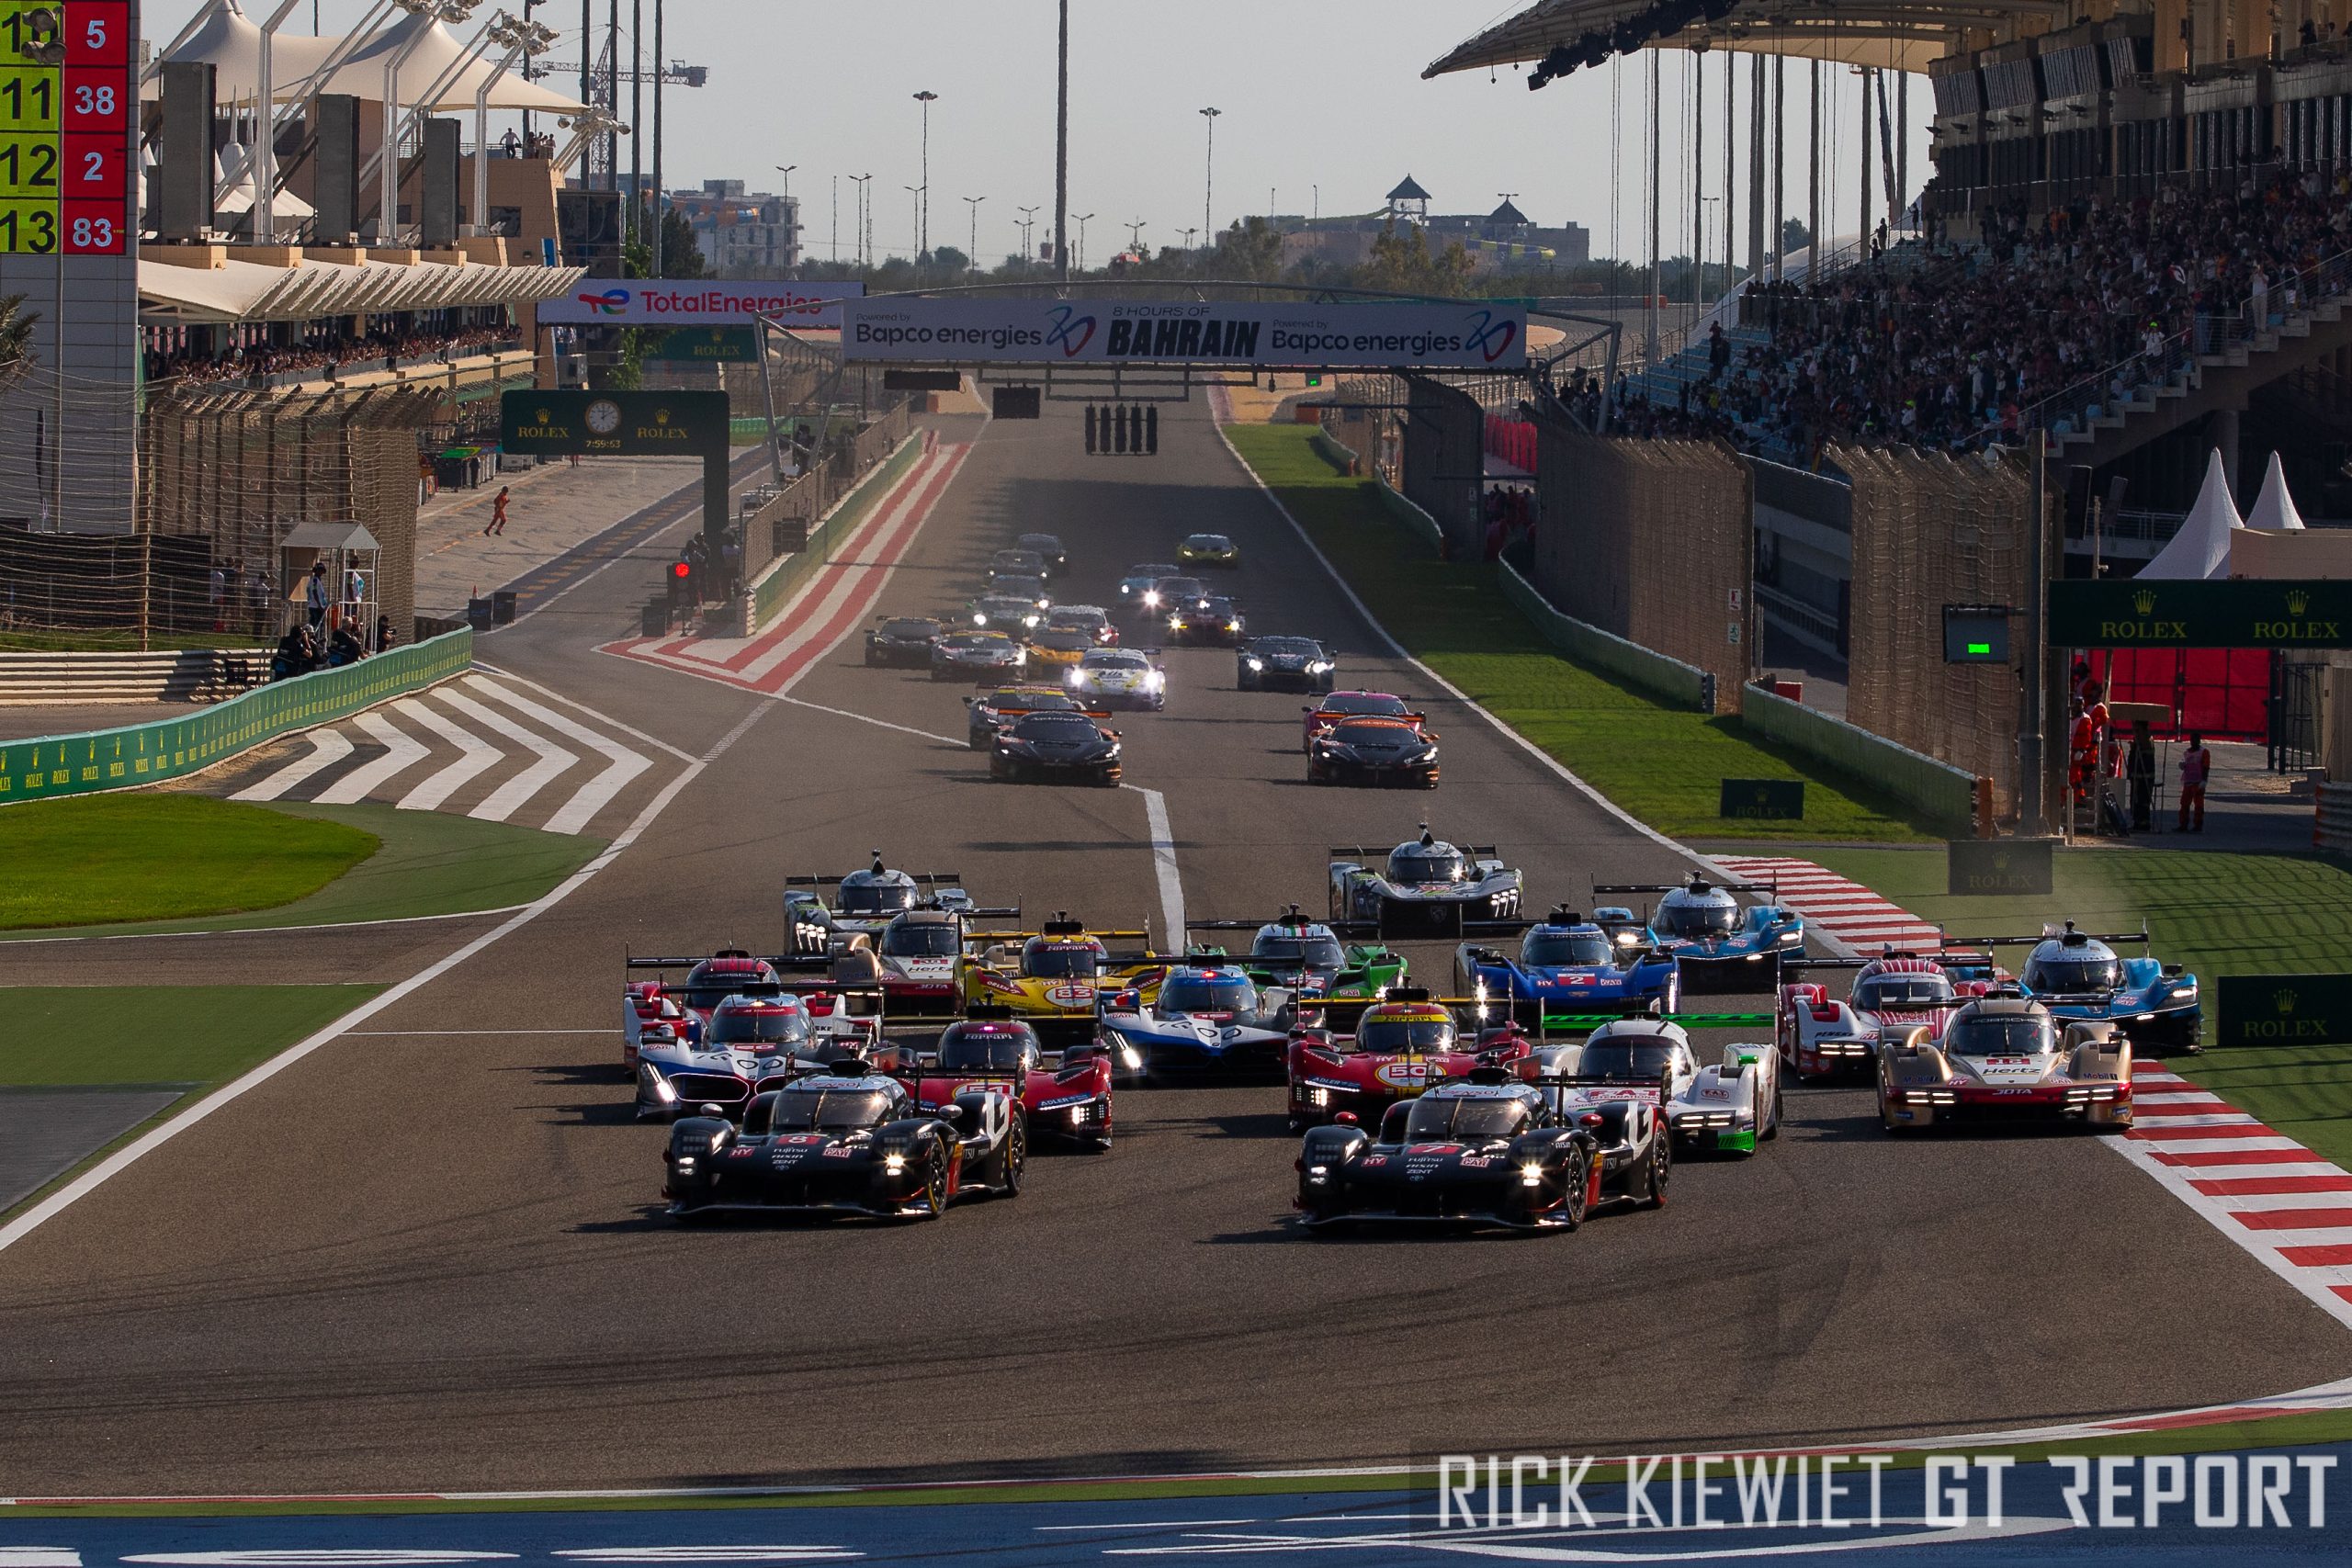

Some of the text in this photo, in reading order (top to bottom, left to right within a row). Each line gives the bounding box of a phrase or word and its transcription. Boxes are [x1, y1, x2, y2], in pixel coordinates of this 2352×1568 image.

[86, 20, 106, 49] 5
[2, 77, 50, 119] 11
[74, 85, 115, 115] 38
[0, 143, 57, 186] 12
[84, 152, 103, 181] 2
[0, 209, 56, 253] 13
[73, 218, 113, 247] 83
[640, 290, 822, 319] TotalEnergies
[1113, 306, 1210, 316] 8 HOURS OF
[856, 313, 910, 322] Powered by
[1273, 320, 1329, 330] Powered by
[856, 322, 1042, 349] Bapco energies
[1106, 319, 1261, 357] BAHRAIN
[1272, 330, 1461, 355] Bapco energies
[694, 344, 740, 356] ROLEX
[517, 426, 569, 438] ROLEX
[637, 426, 687, 439] ROLEX
[2101, 621, 2188, 637] ROLEX
[2253, 622, 2339, 638] ROLEX
[1735, 807, 1788, 818] ROLEX
[1969, 876, 2033, 889] ROLEX
[986, 980, 1010, 992] ORLEN
[1570, 976, 1585, 985] 2
[1057, 988, 1091, 998] 83
[2243, 1020, 2330, 1038] ROLEX
[1391, 1066, 1427, 1077] 50
[1312, 1077, 1340, 1086] ADLER
[1041, 1097, 1069, 1106] ADLER
[788, 1135, 808, 1144] 8
[731, 1147, 752, 1156] HY
[1364, 1157, 1385, 1166] HY
